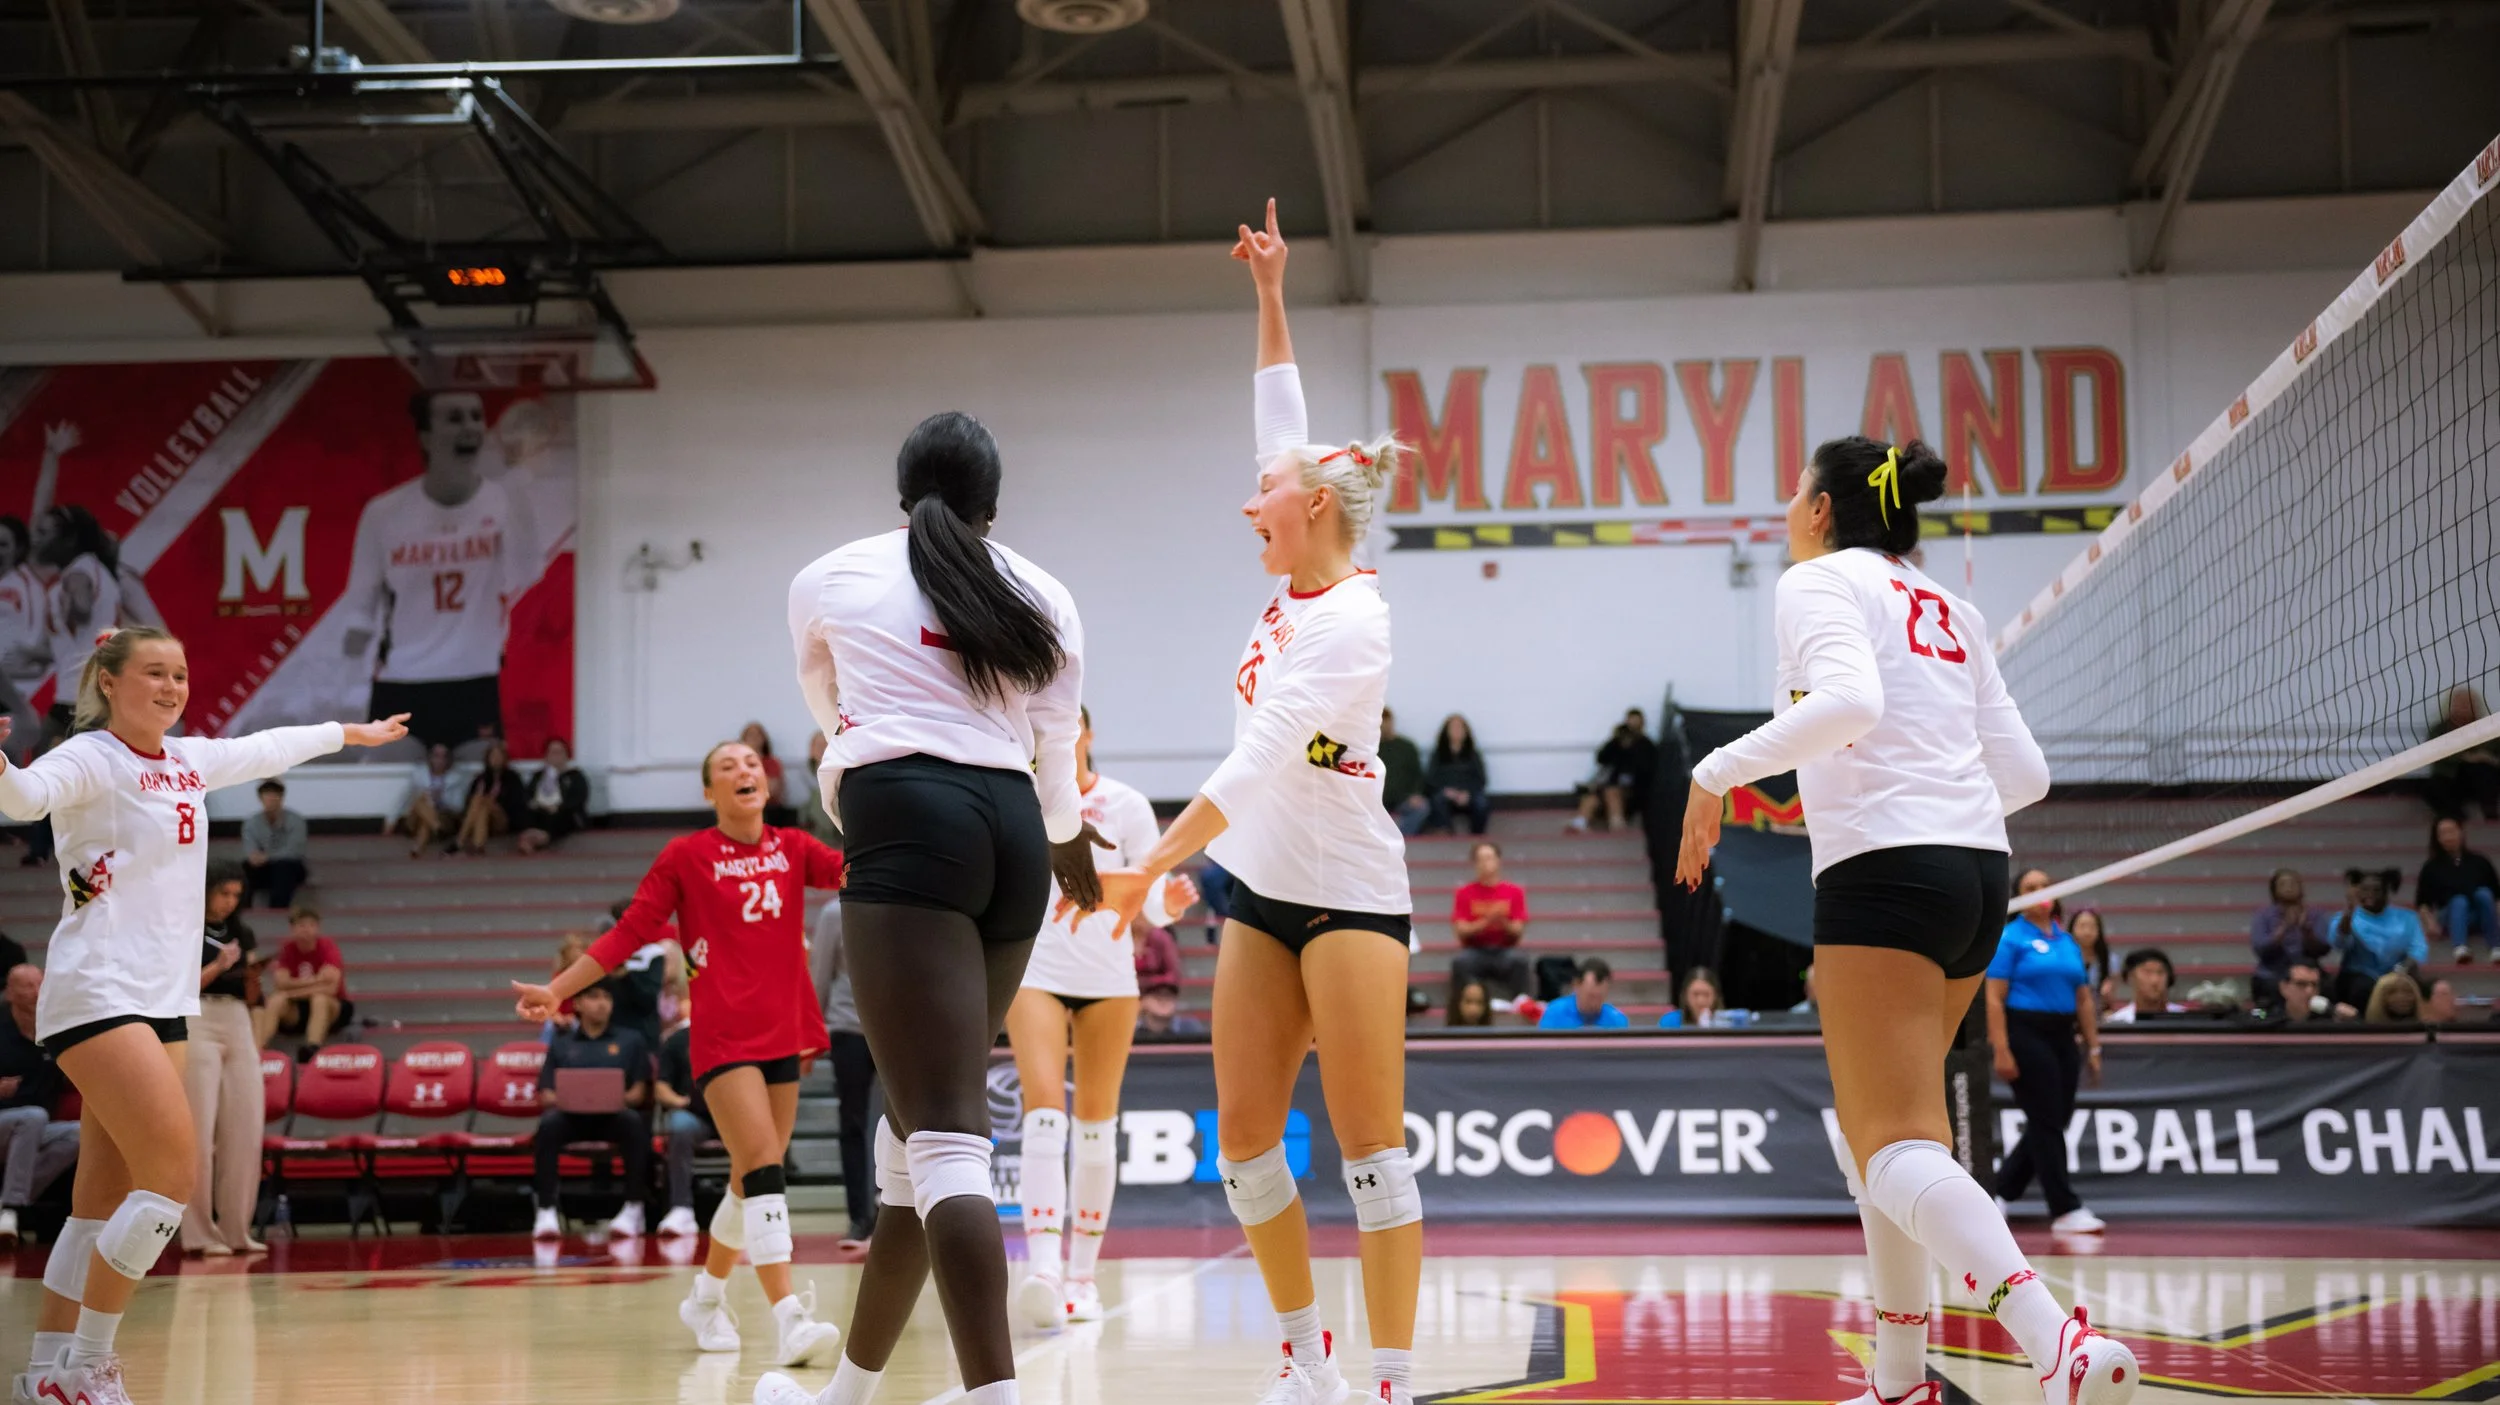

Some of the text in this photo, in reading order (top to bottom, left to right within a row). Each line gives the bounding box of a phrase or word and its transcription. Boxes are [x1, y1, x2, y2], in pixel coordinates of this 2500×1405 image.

[115, 366, 262, 517] VOLLEYBALL
[1383, 346, 2127, 512] MARYLAND
[217, 506, 311, 602] M
[433, 571, 466, 614] 12
[1889, 577, 1967, 664] 23
[175, 802, 196, 845] 8
[713, 850, 790, 881] MARYLAND
[739, 879, 783, 923] 24
[2302, 1105, 2500, 1175] CHAL
